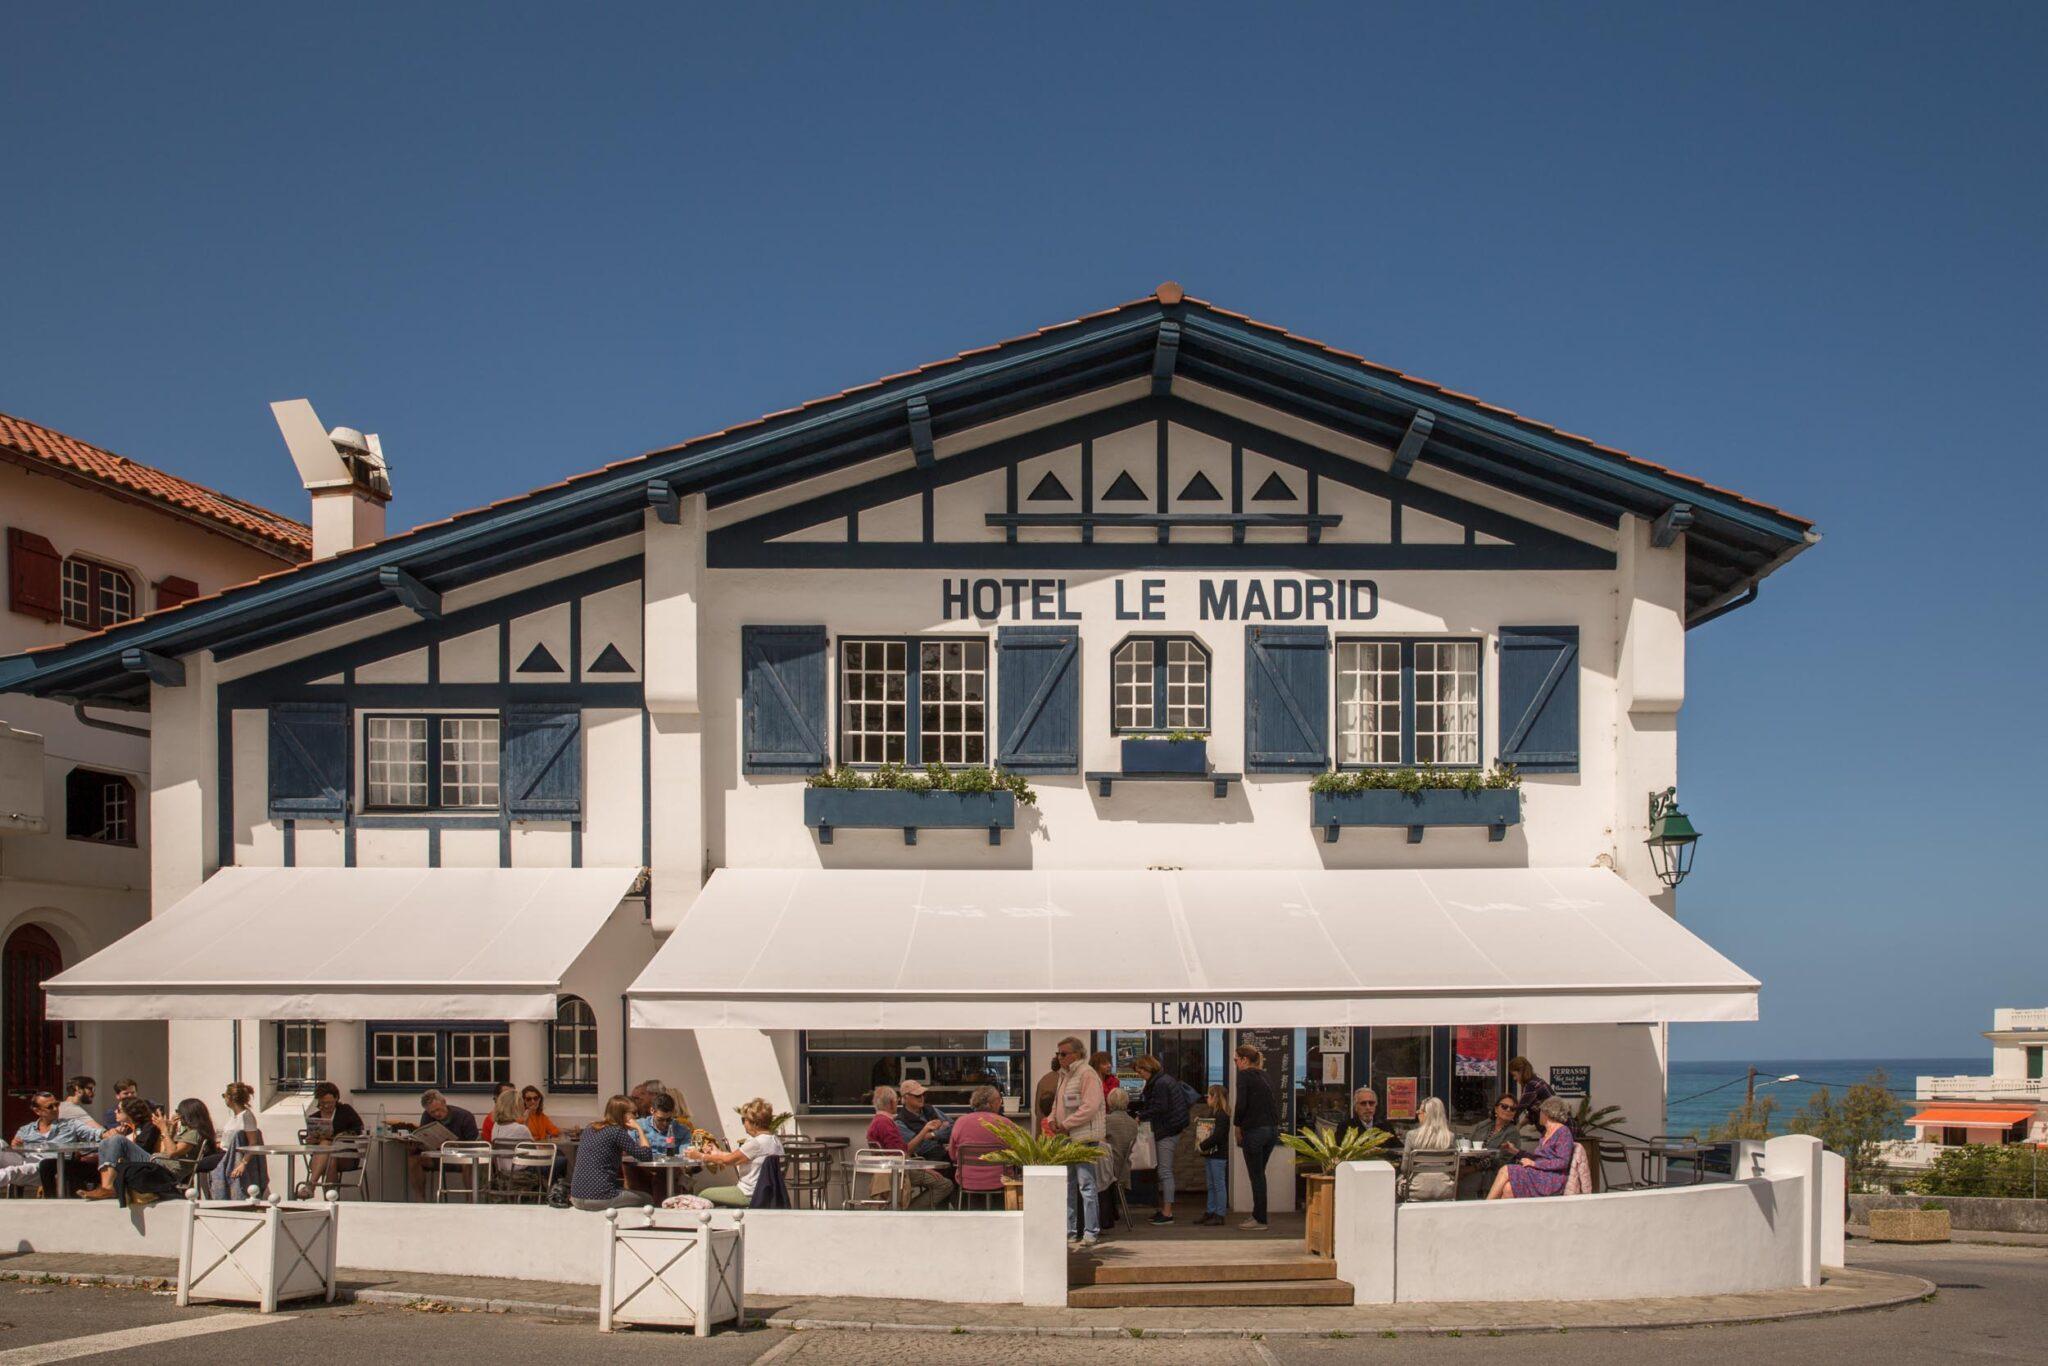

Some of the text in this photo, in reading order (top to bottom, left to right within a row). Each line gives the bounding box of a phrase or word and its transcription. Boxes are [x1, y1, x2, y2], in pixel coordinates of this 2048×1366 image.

[943, 578, 1379, 621] HOTEL LE MADRID
[1151, 1001, 1243, 1025] LE MADRID
[1552, 1067, 1588, 1075] TERRASSE
